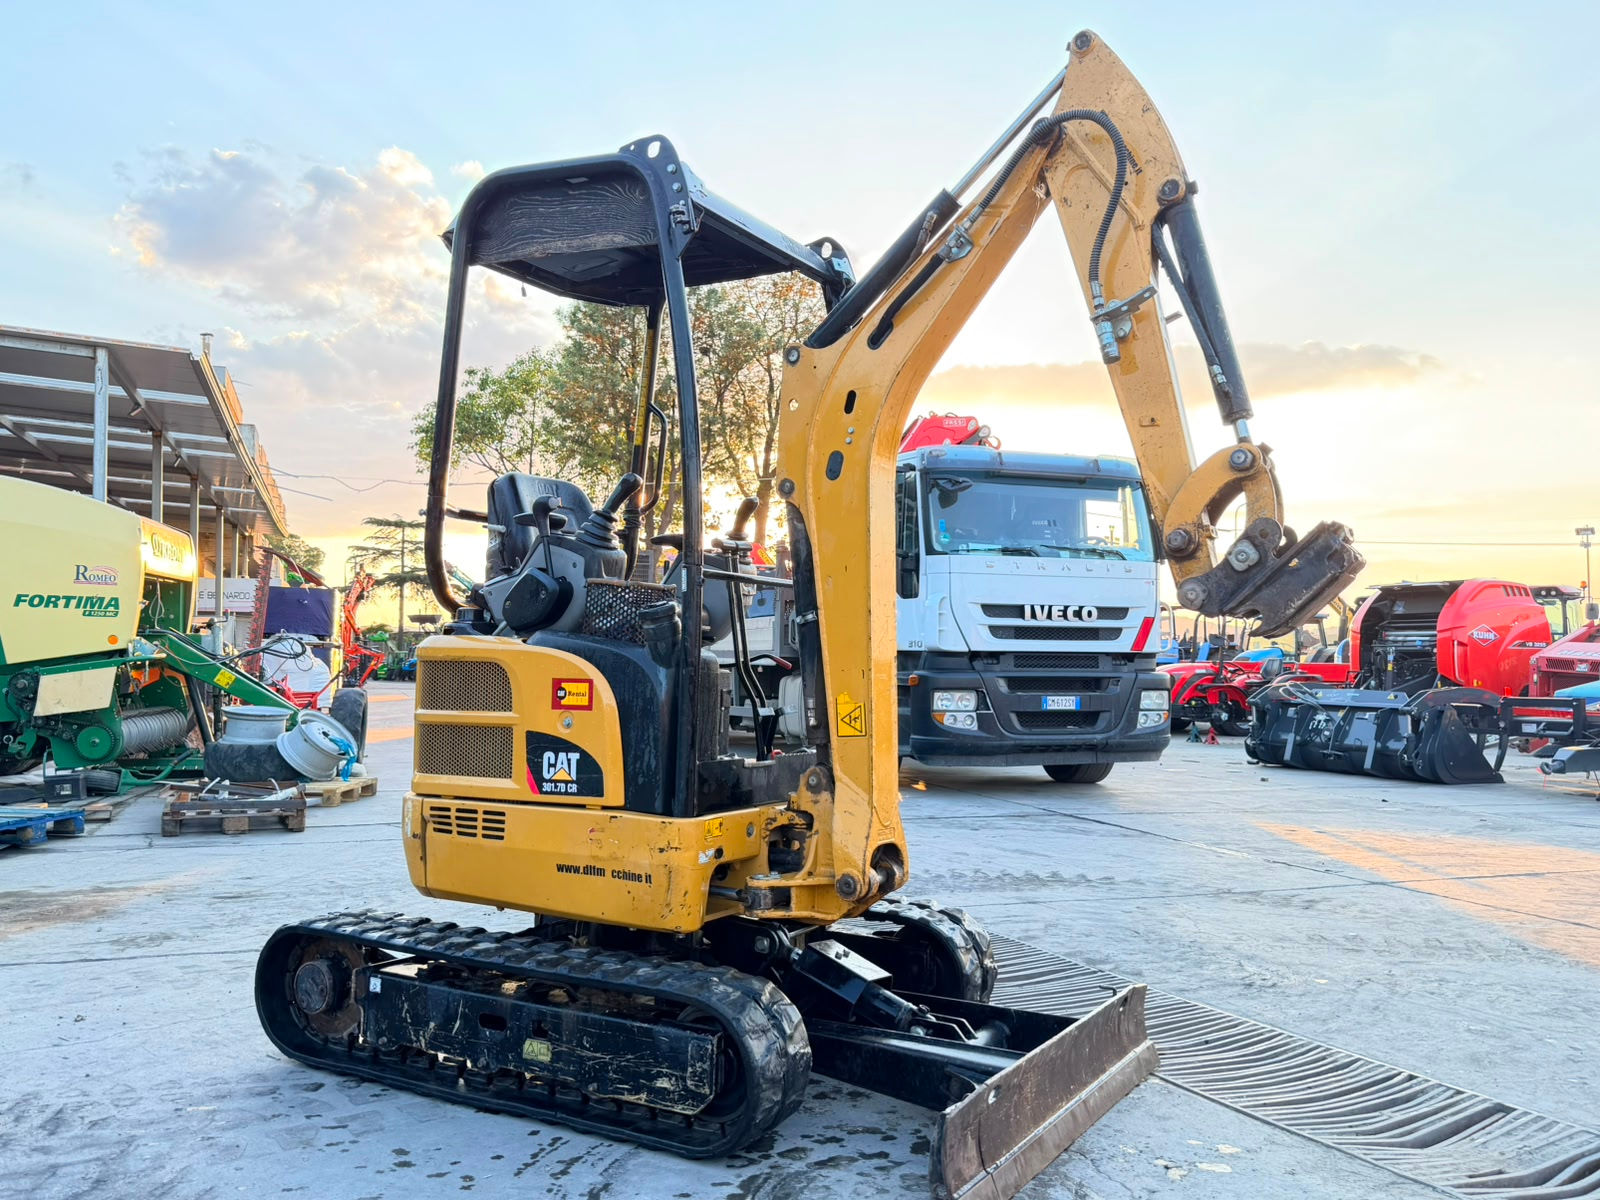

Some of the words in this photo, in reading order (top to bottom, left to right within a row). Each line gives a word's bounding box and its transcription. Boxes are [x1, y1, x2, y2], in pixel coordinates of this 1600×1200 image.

[985, 561, 1132, 573] STRALIS
[13, 593, 120, 610] FORTIMA
[1024, 604, 1098, 622] IVECO
[542, 751, 580, 781] CAT
[542, 782, 566, 792] 301.7D
[567, 783, 577, 793] CR
